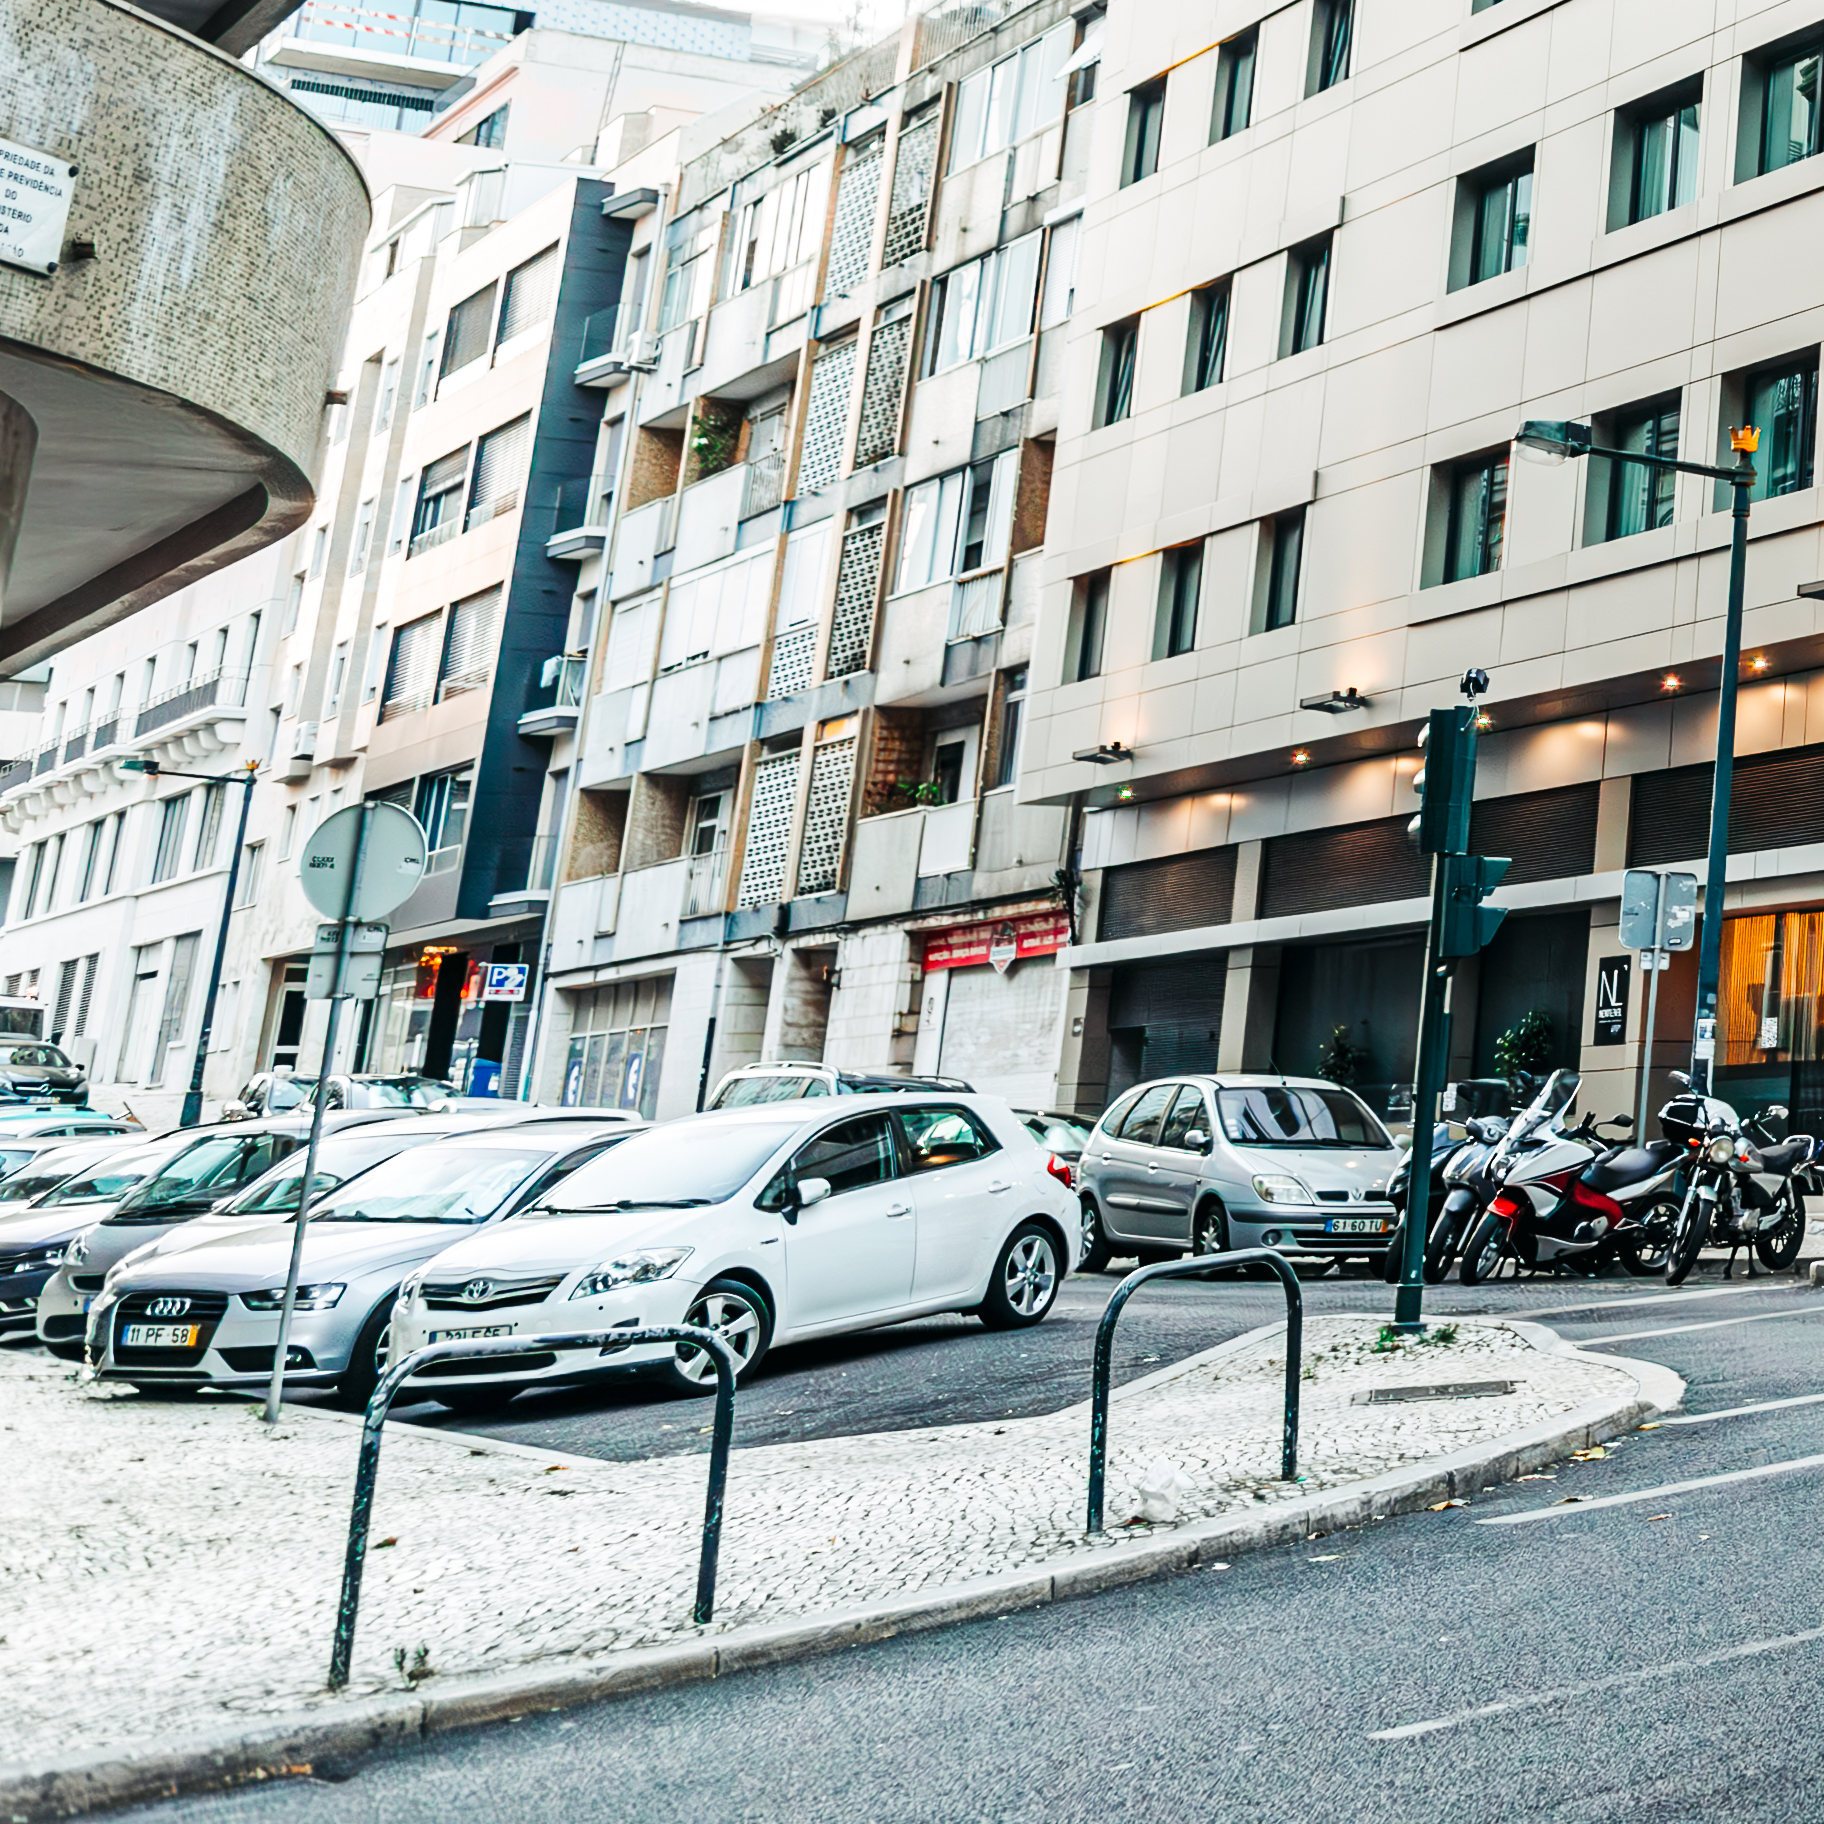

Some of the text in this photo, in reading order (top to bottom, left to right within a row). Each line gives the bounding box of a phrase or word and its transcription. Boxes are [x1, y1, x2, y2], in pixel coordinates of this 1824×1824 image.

[43, 164, 55, 177] DA
[7, 170, 63, 198] PREVIDÊNCIA
[4, 188, 18, 201] DO
[145, 1327, 165, 1344] PF
[171, 1327, 189, 1344] 58
